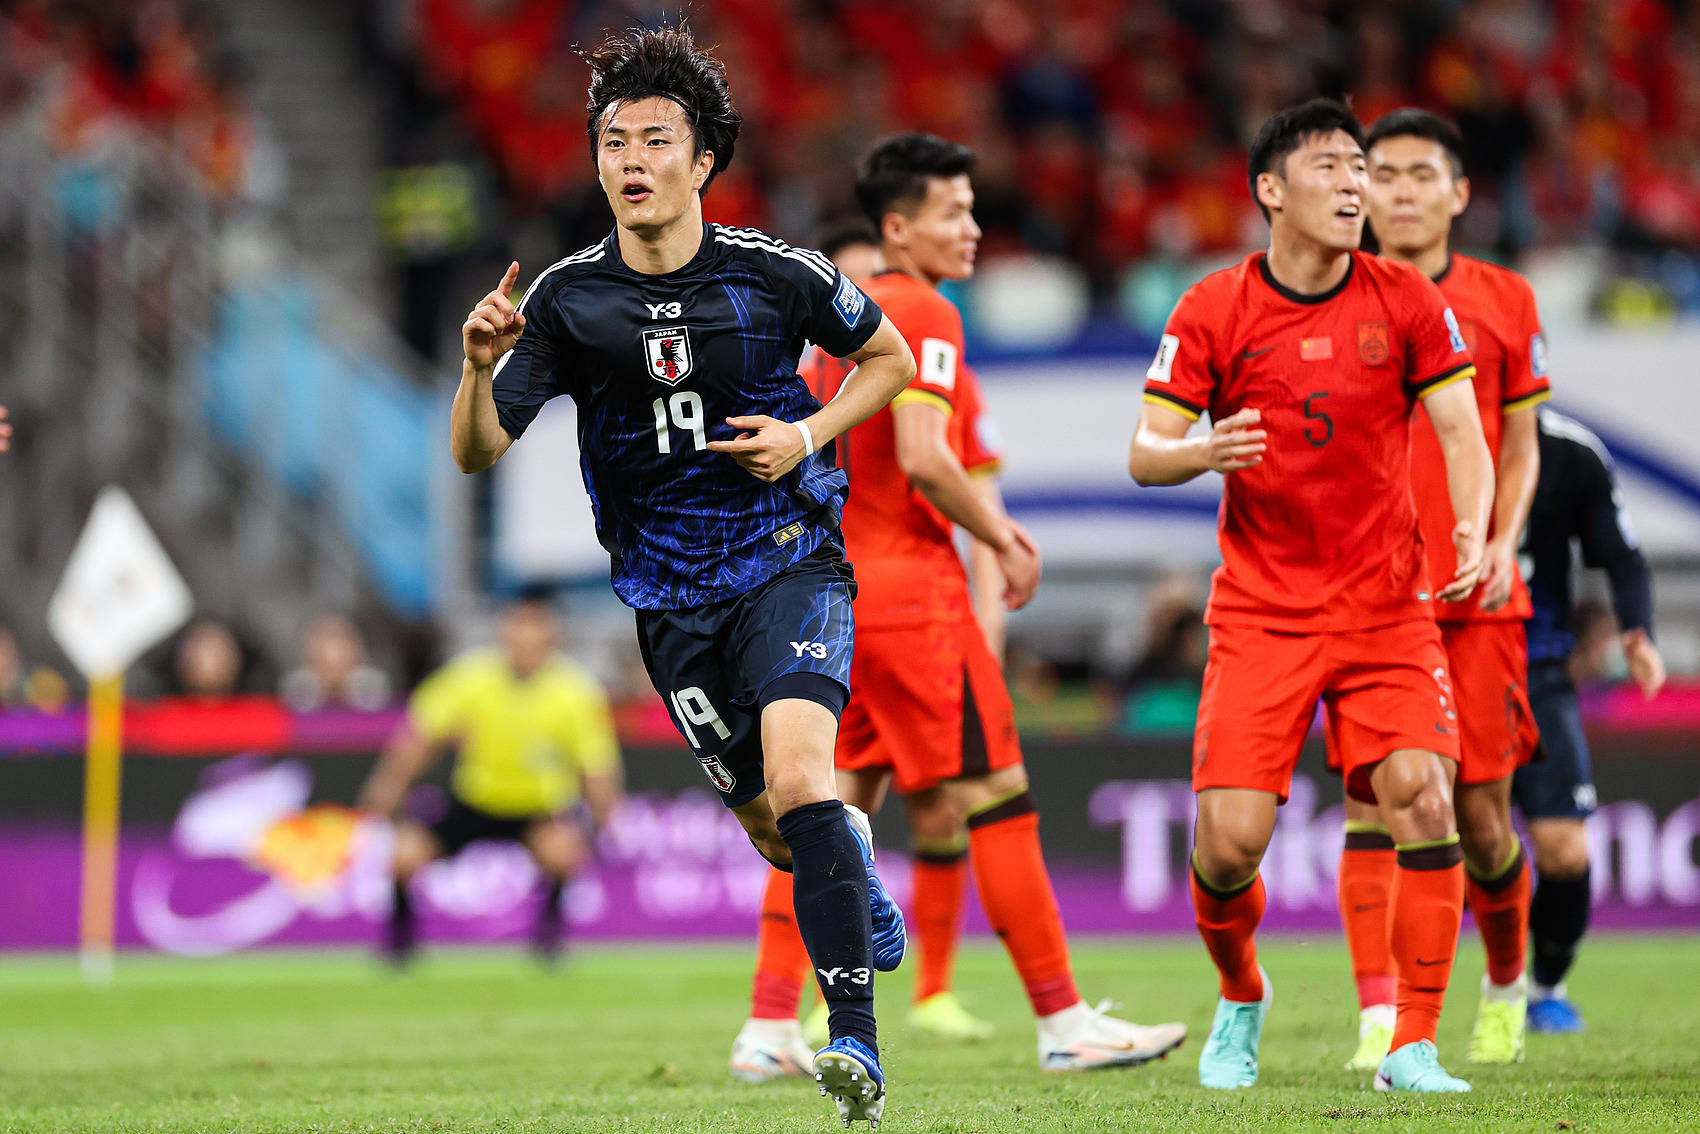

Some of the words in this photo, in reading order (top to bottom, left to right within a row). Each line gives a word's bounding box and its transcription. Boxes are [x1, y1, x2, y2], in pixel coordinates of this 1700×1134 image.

[645, 302, 682, 320] Y-3
[654, 329, 678, 338] JAPAN
[662, 365, 681, 376] JFA
[652, 391, 707, 454] 19
[1302, 392, 1334, 448] 5
[788, 640, 828, 659] Y-3
[670, 686, 732, 749] 19
[817, 966, 871, 985] Y-3
